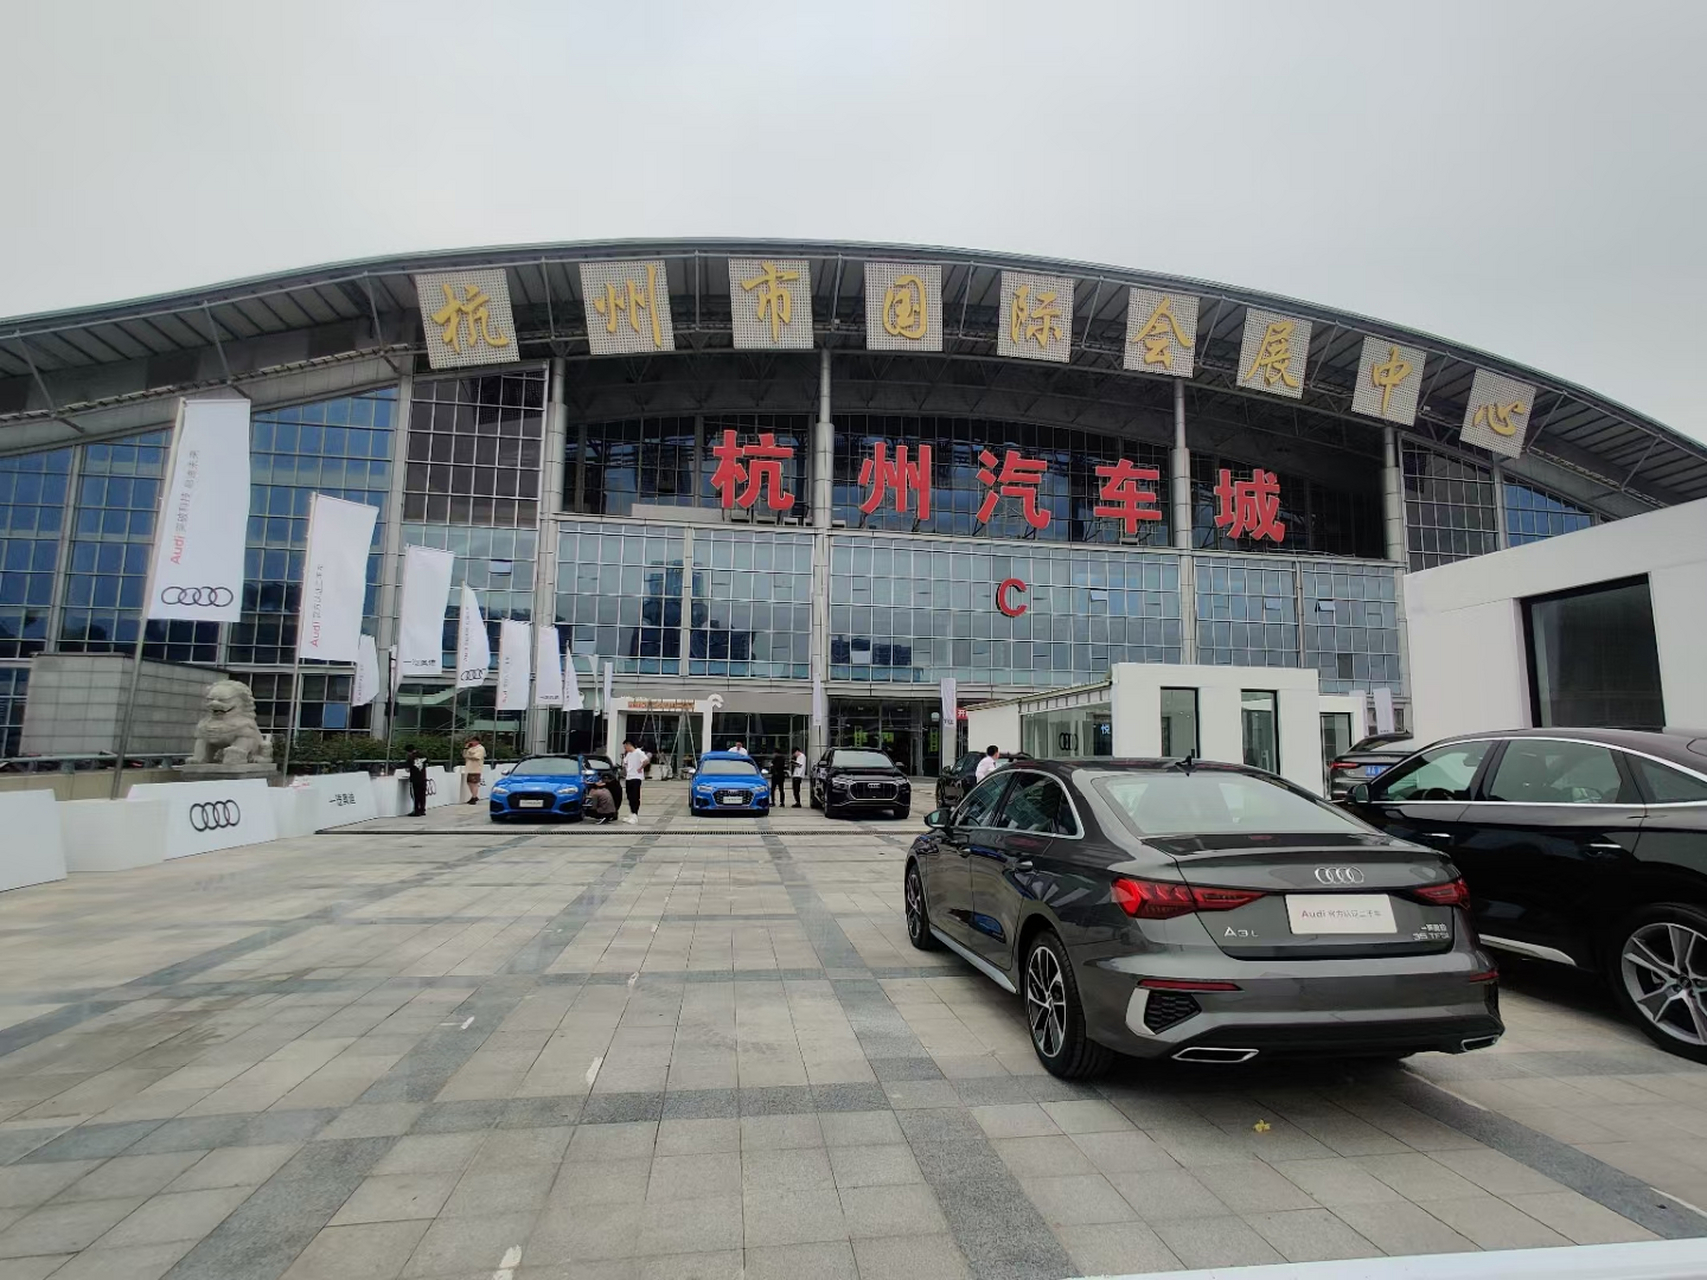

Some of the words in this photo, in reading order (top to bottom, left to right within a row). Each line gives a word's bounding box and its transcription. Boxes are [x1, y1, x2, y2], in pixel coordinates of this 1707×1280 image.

[429, 262, 1526, 437] 杭州市国际会展中心
[710, 429, 1286, 542] 杭州汽车城
[169, 535, 185, 565] Audi
[997, 577, 1027, 619] C
[1301, 909, 1327, 919] Audi
